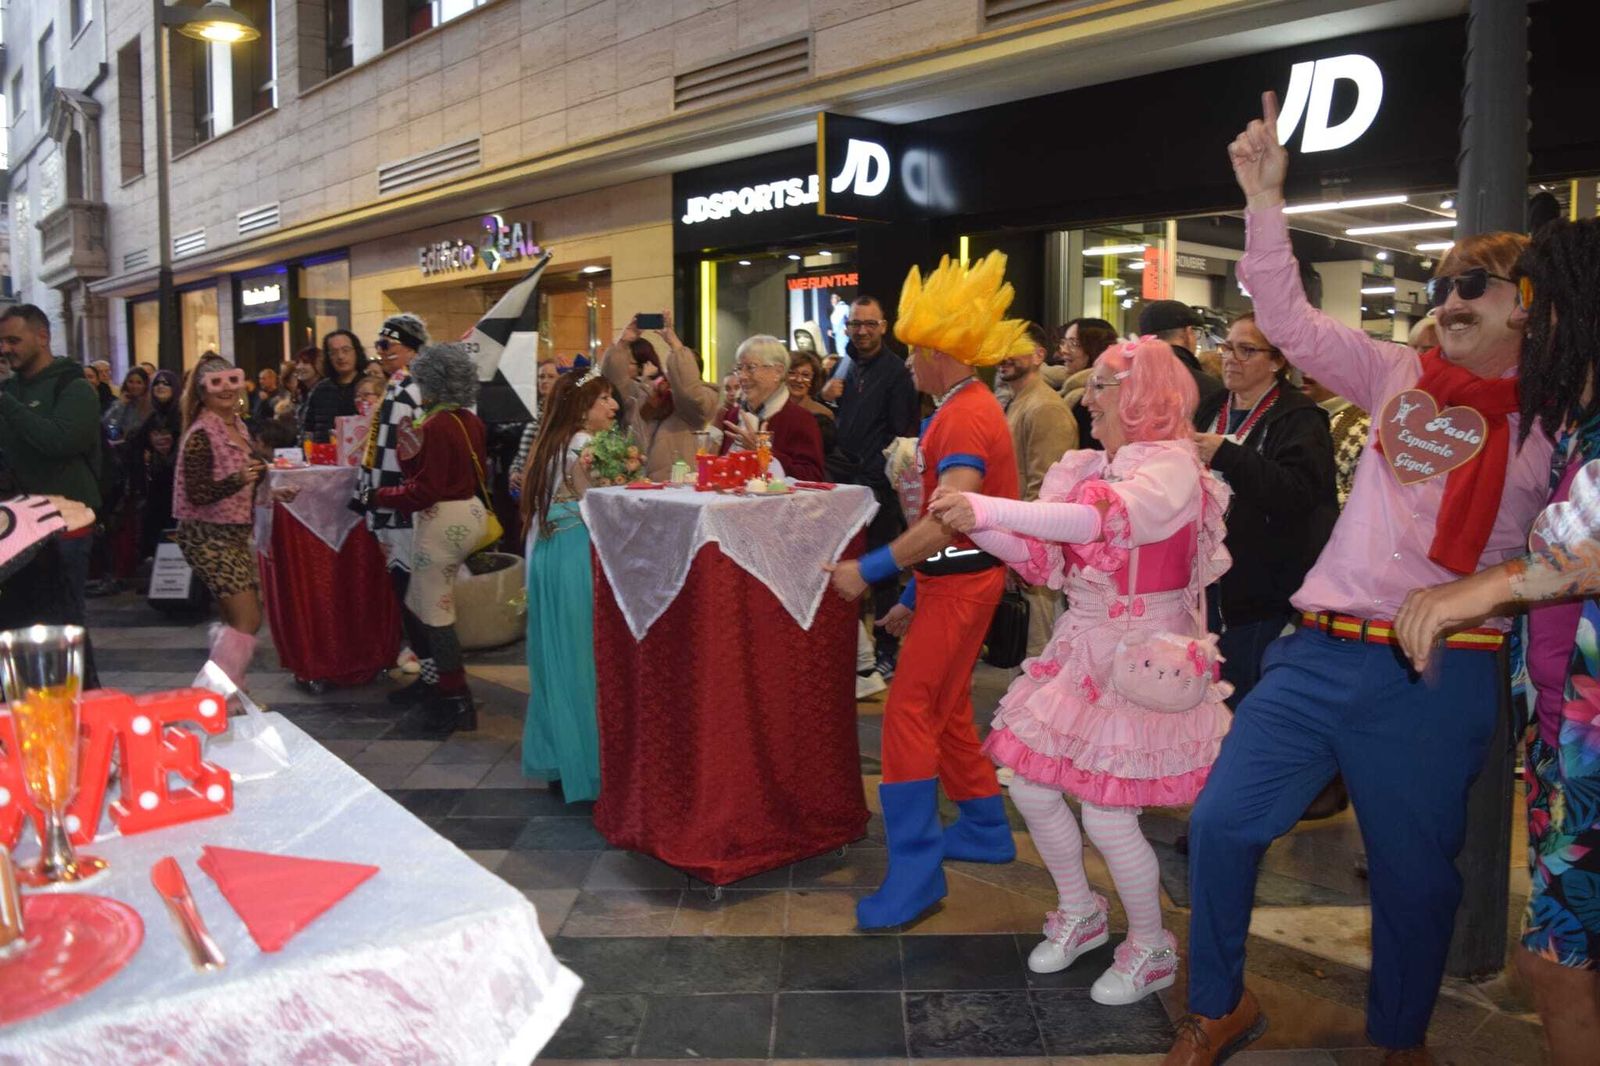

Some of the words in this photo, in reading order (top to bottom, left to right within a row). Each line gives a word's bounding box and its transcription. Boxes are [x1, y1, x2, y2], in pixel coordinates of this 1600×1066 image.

[1276, 54, 1384, 154] JD
[831, 139, 890, 197] JD
[418, 240, 474, 275] Edificio
[1425, 417, 1481, 444] Paolo
